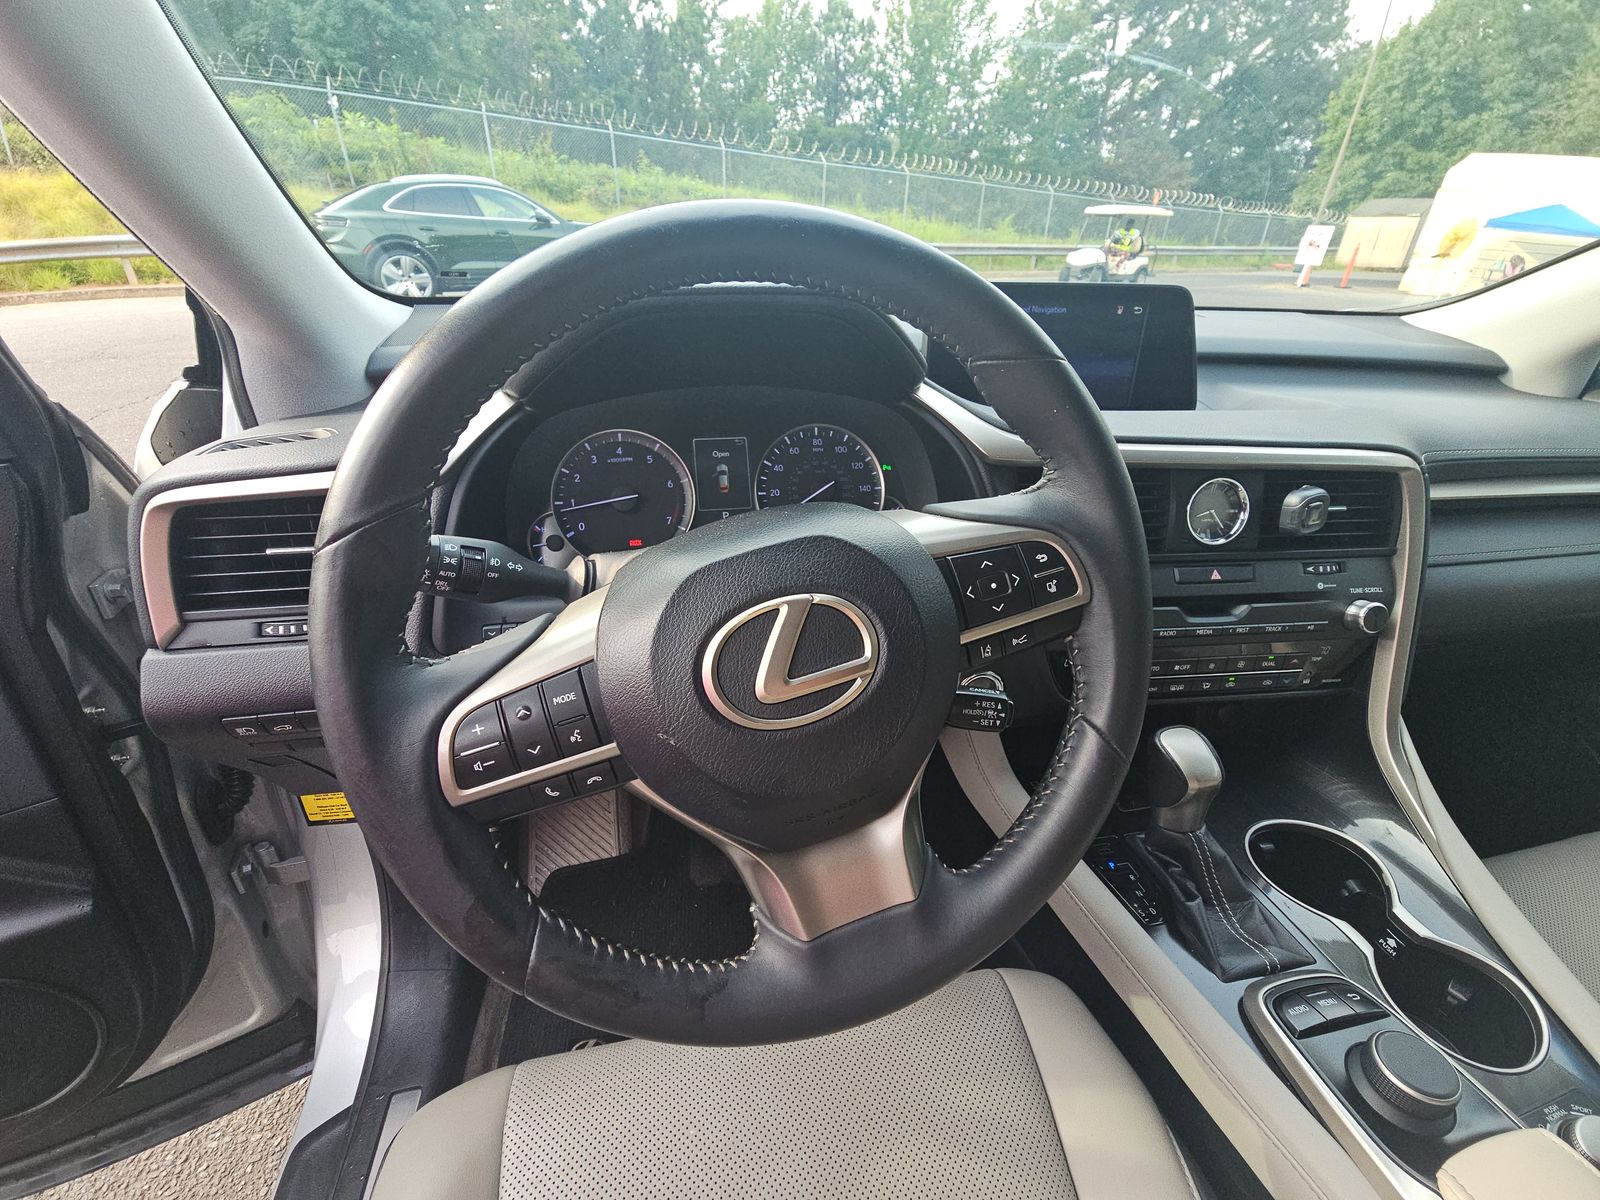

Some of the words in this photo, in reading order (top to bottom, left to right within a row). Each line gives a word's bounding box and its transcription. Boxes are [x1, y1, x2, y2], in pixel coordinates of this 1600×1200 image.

[1032, 305, 1067, 315] Navigation
[616, 447, 622, 455] 4
[712, 450, 730, 458] Open
[790, 447, 800, 455] 60
[591, 455, 597, 464] 3
[647, 455, 653, 464] 5
[773, 464, 784, 472] 40
[574, 474, 580, 483] 2
[667, 480, 674, 488] 6
[770, 489, 780, 497] 20
[722, 511, 730, 519] P
[666, 517, 672, 525] 7
[578, 522, 585, 531] 0
[438, 570, 456, 578] AUTO
[487, 571, 499, 579] OFF
[552, 692, 577, 706] MODE
[962, 708, 978, 716] HOLD
[1288, 1004, 1309, 1016] AUDIO
[1316, 998, 1338, 1008] MENU
[1570, 1103, 1593, 1115] SPORT
